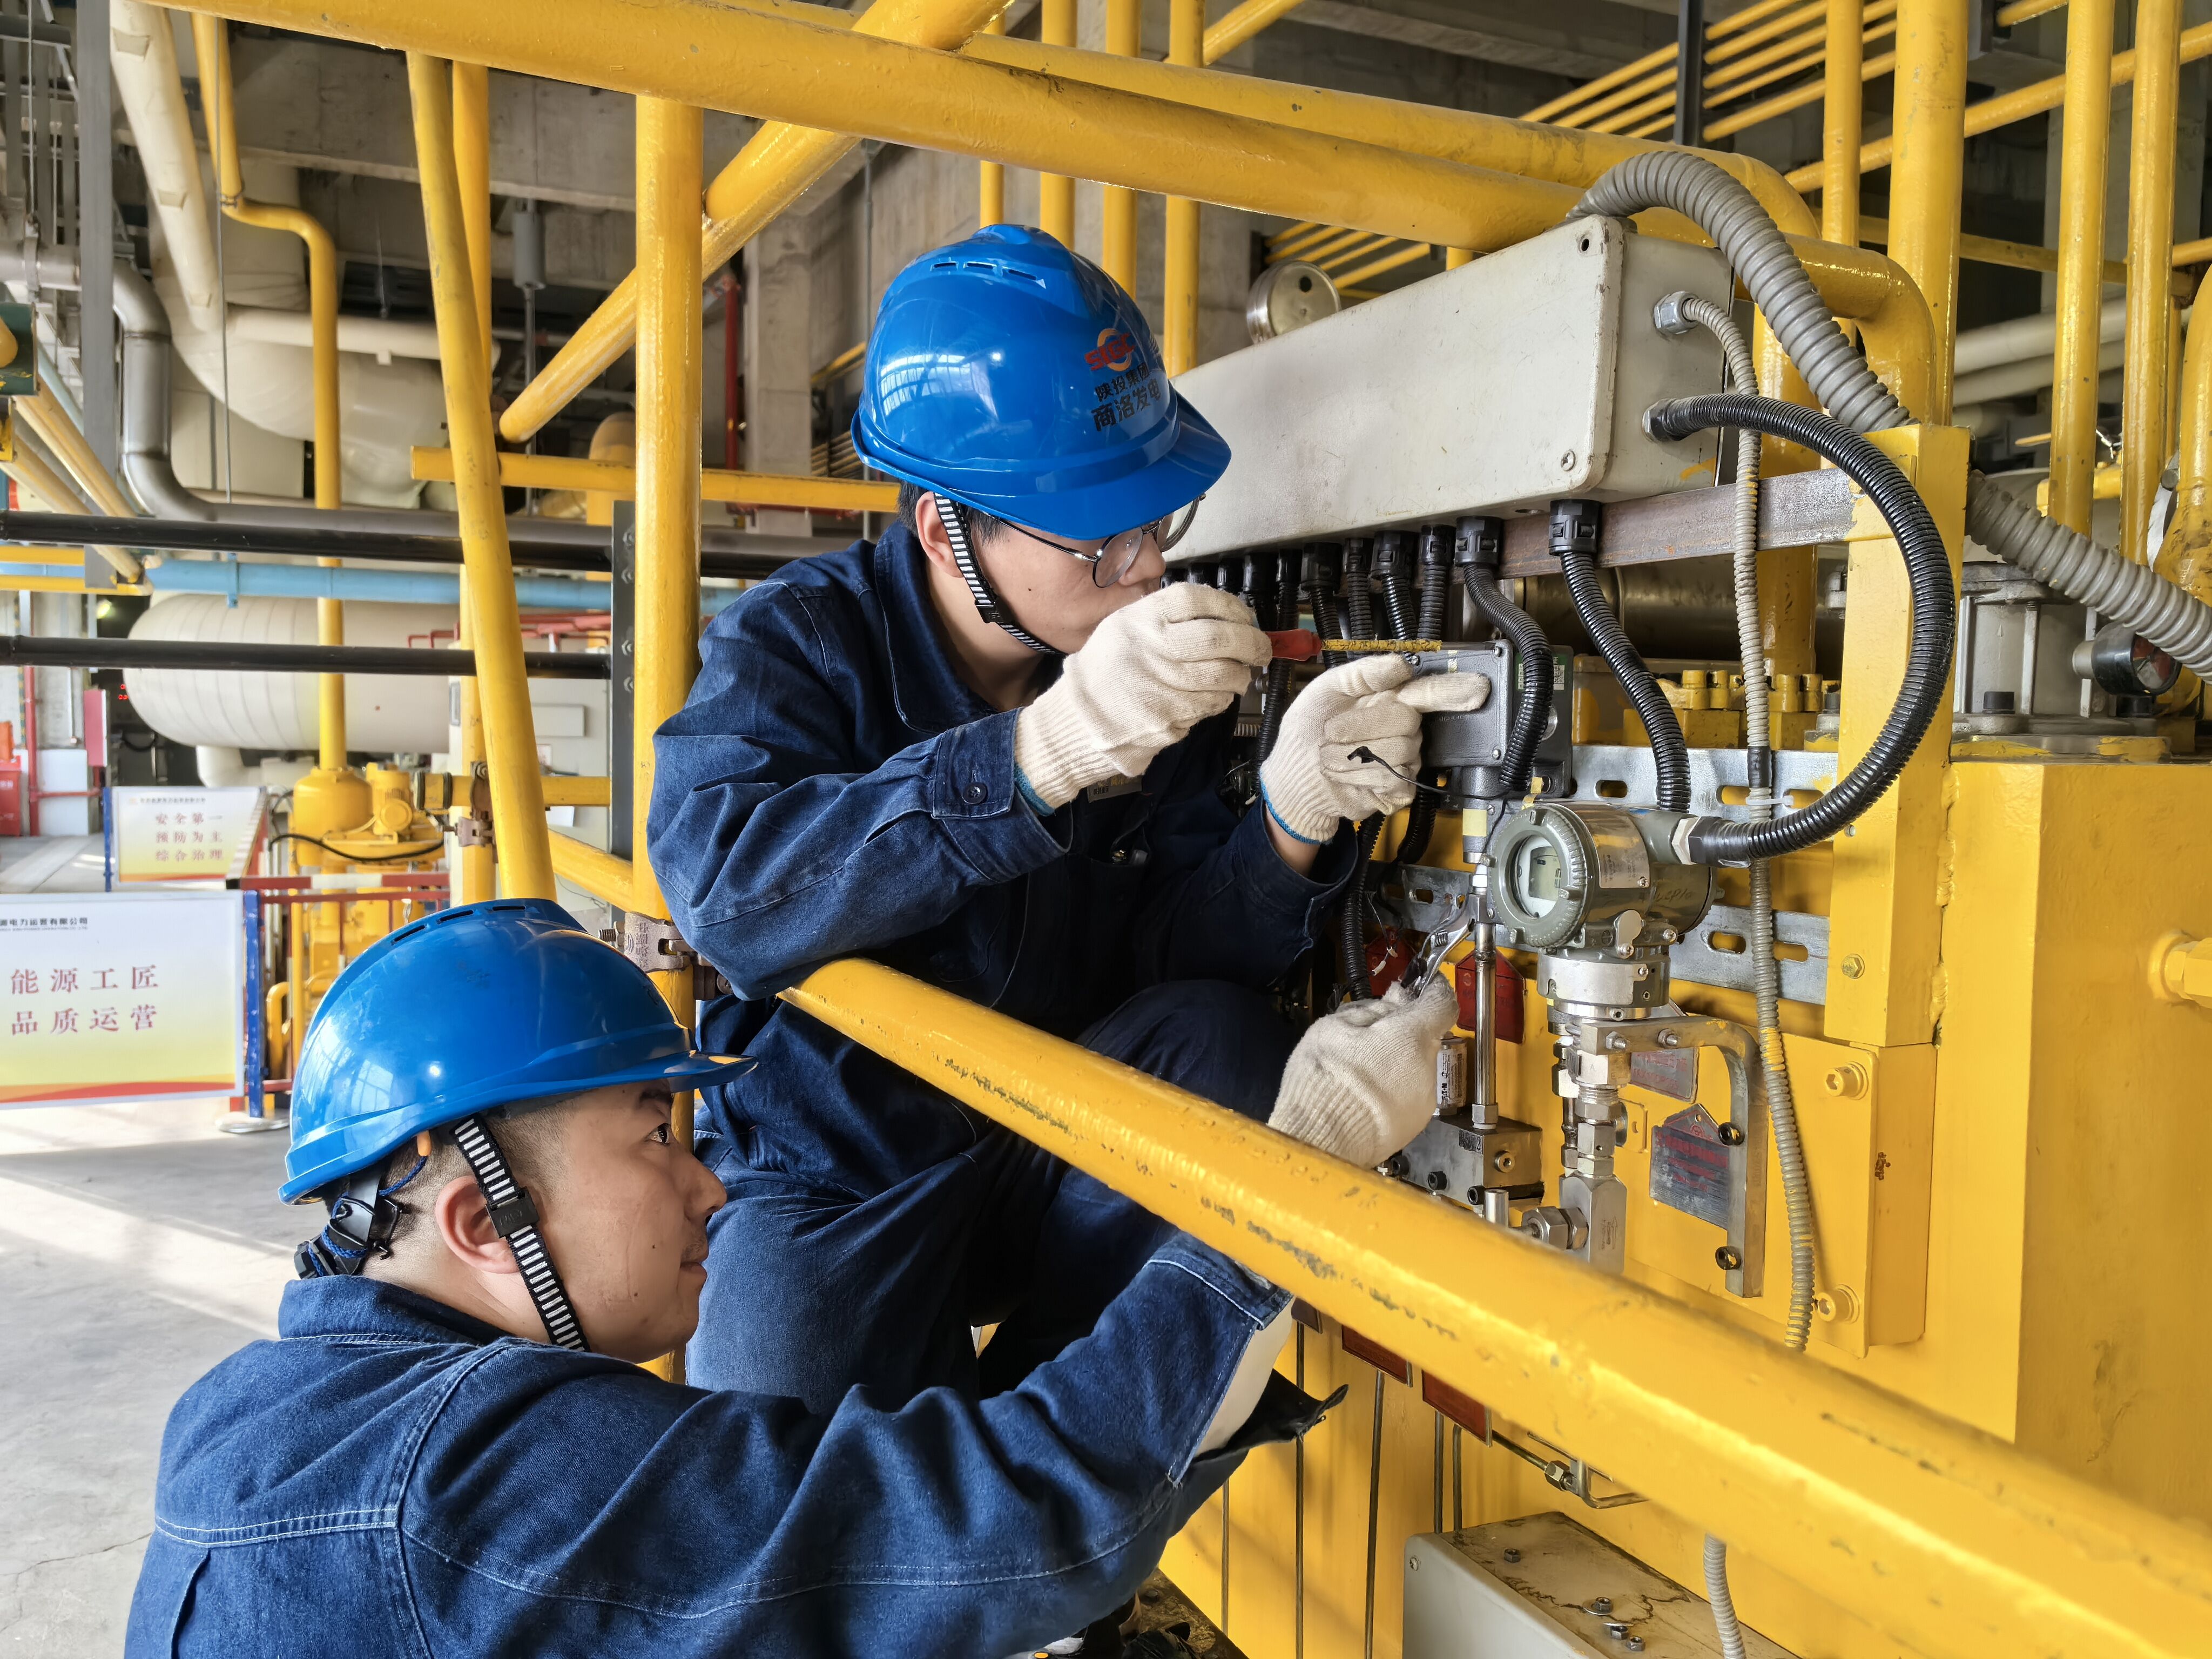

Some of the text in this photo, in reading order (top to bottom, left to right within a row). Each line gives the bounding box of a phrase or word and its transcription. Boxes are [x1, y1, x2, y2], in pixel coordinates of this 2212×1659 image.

[1095, 362, 1150, 402] 陕投集团
[1091, 378, 1161, 431] 商洛发电
[156, 812, 223, 825] 安全第一
[156, 830, 223, 844] 预防为主
[156, 848, 223, 862] 综合治理
[11, 964, 158, 995] 能源工匠
[12, 1003, 157, 1036] 品质运营
